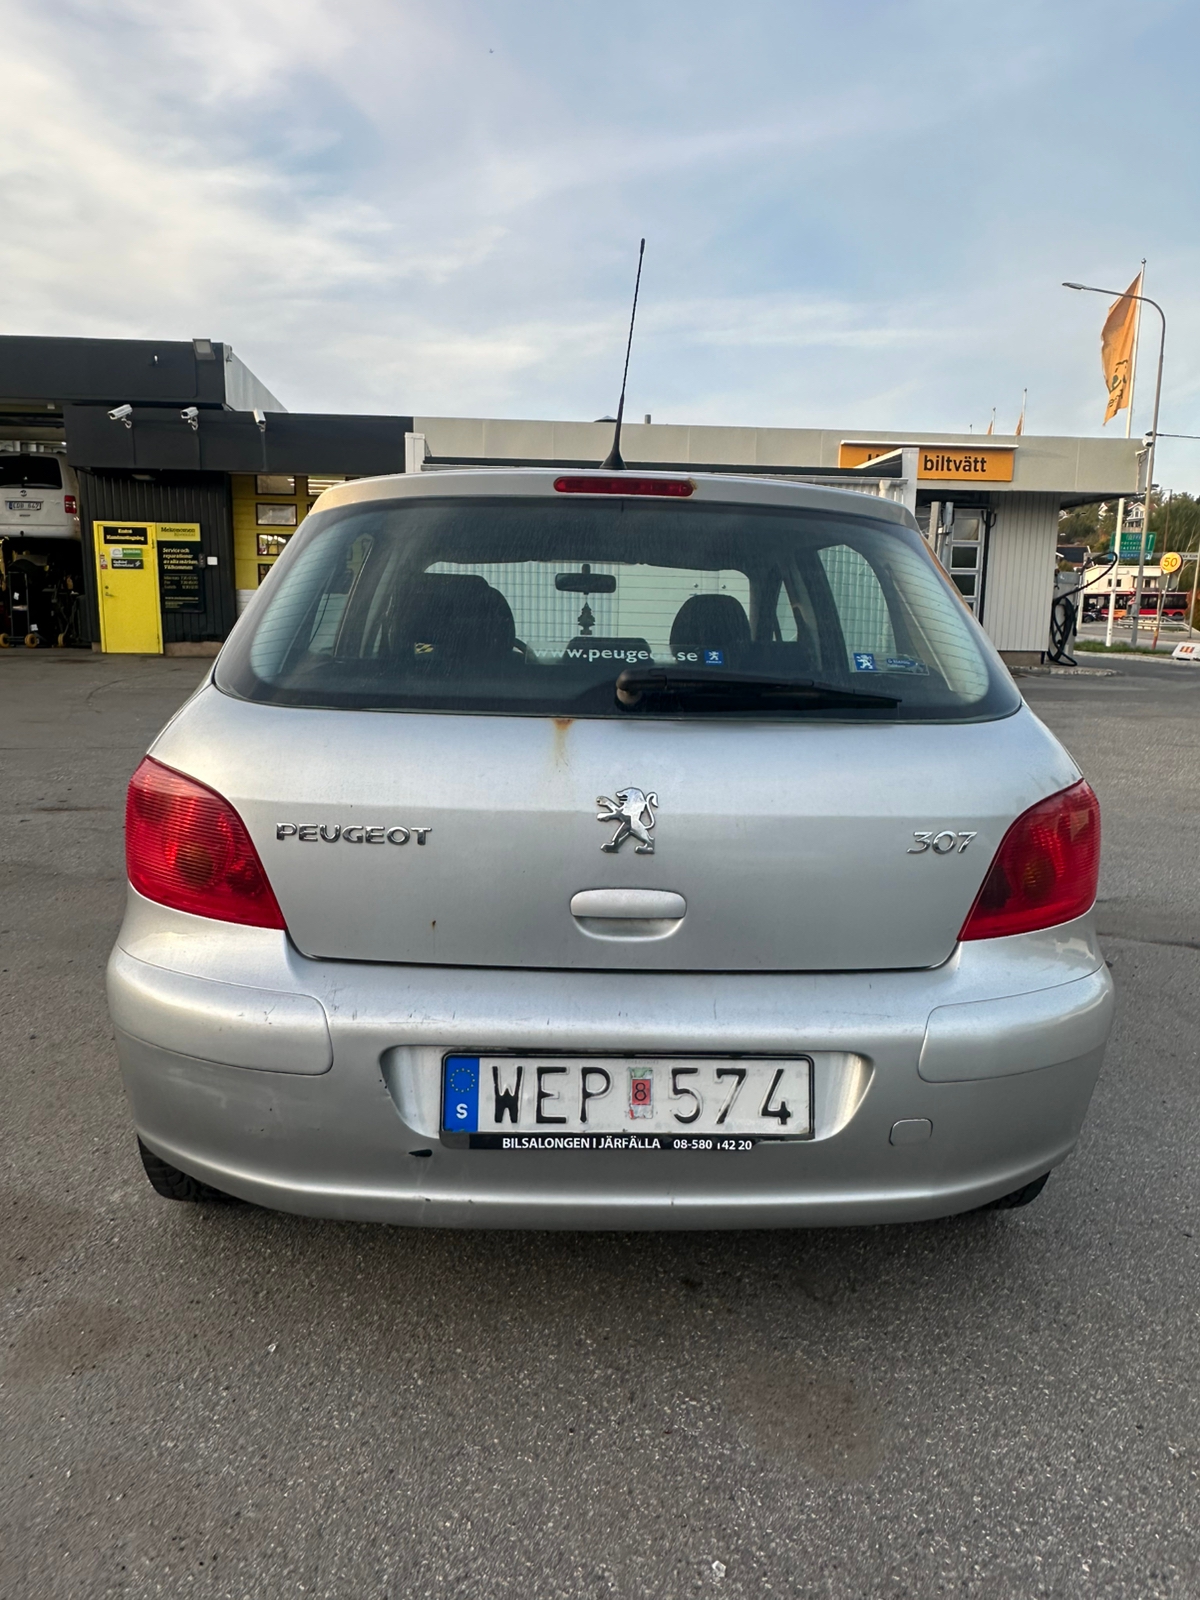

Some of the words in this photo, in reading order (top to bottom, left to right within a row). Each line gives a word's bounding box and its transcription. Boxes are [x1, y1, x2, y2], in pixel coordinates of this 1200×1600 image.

[923, 454, 987, 473] biltvätt
[1163, 557, 1178, 568] 50
[533, 647, 698, 663] www.peuge.se
[276, 822, 433, 846] PEUGEOT
[906, 830, 978, 855] 307
[456, 1103, 468, 1119] S
[491, 1065, 612, 1124] WEP
[634, 1082, 647, 1101] 8
[669, 1066, 793, 1126] 574
[502, 1137, 590, 1149] BILSALONGEN
[592, 1138, 596, 1149] I
[598, 1135, 661, 1149] JÄRFÄLLA
[673, 1139, 713, 1150] 08-580
[738, 1140, 753, 1150] 20
